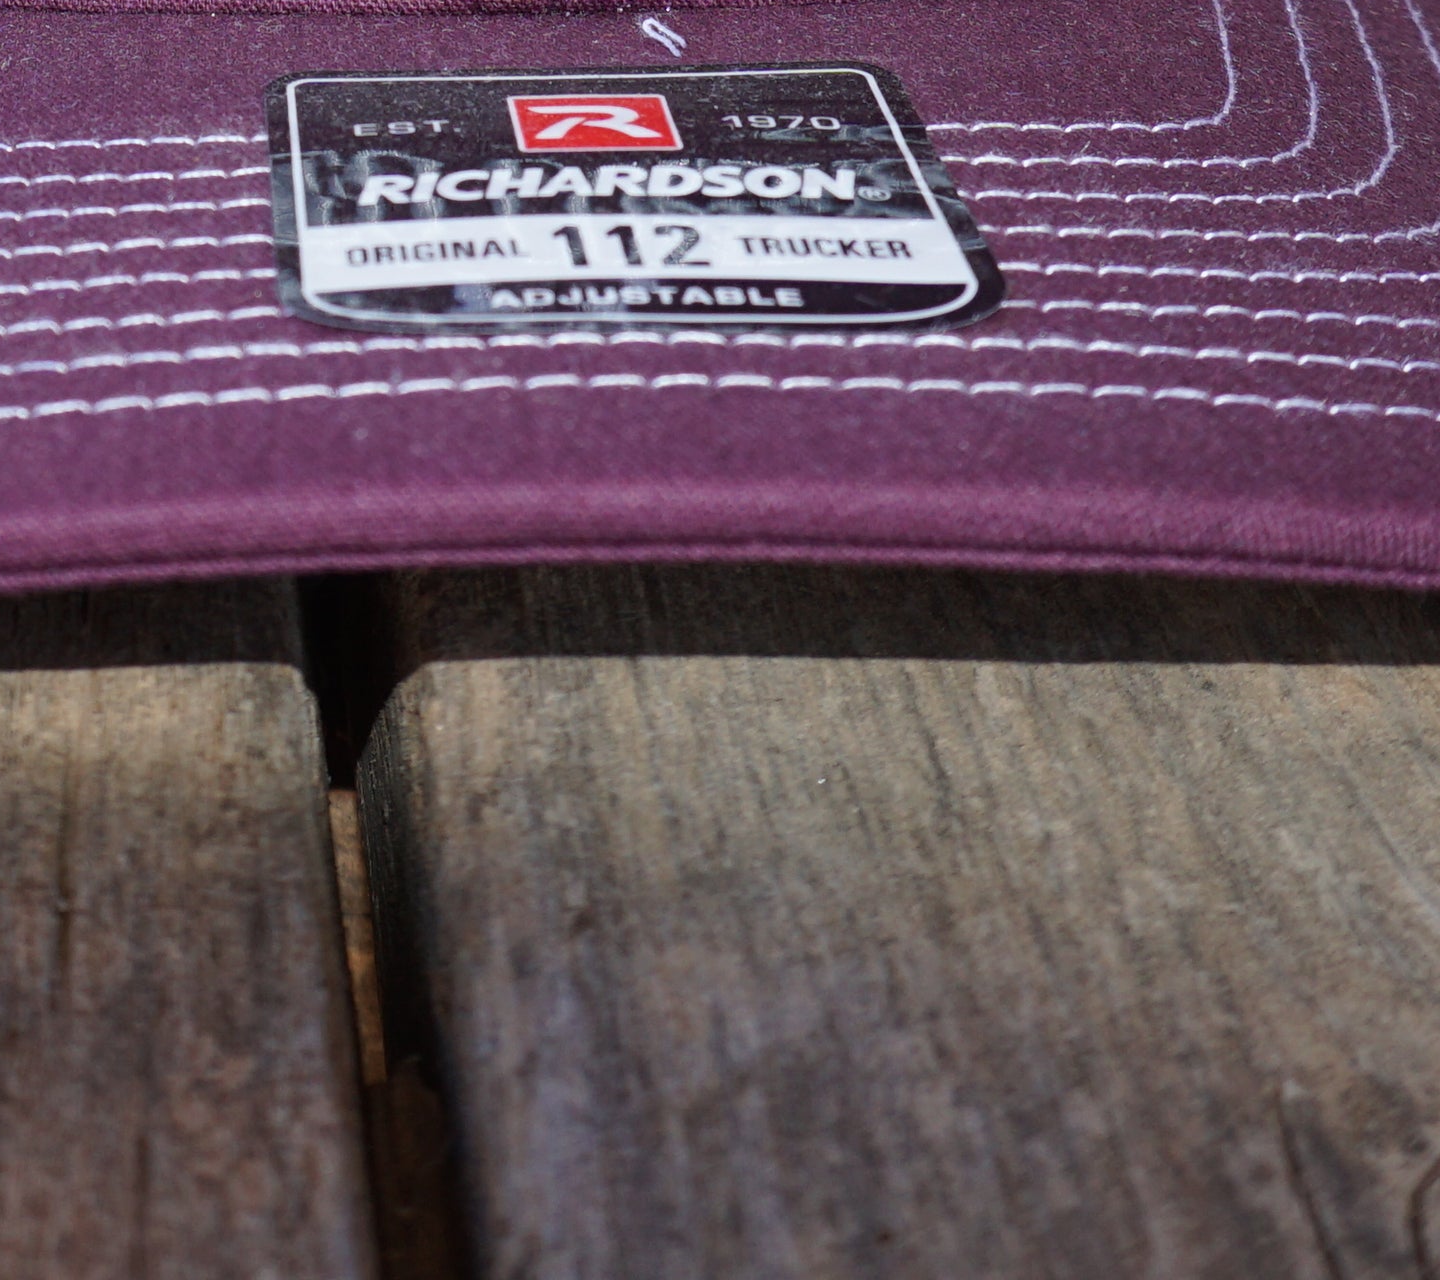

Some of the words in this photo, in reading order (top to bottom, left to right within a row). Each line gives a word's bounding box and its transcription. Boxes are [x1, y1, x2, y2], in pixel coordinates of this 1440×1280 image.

[353, 119, 461, 136] EST.
[721, 115, 840, 130] 1970
[347, 240, 527, 265] ORIGINAL
[553, 225, 710, 266] 112
[738, 237, 912, 259] TRUCKER
[490, 286, 804, 308] ADJUSTABLE
